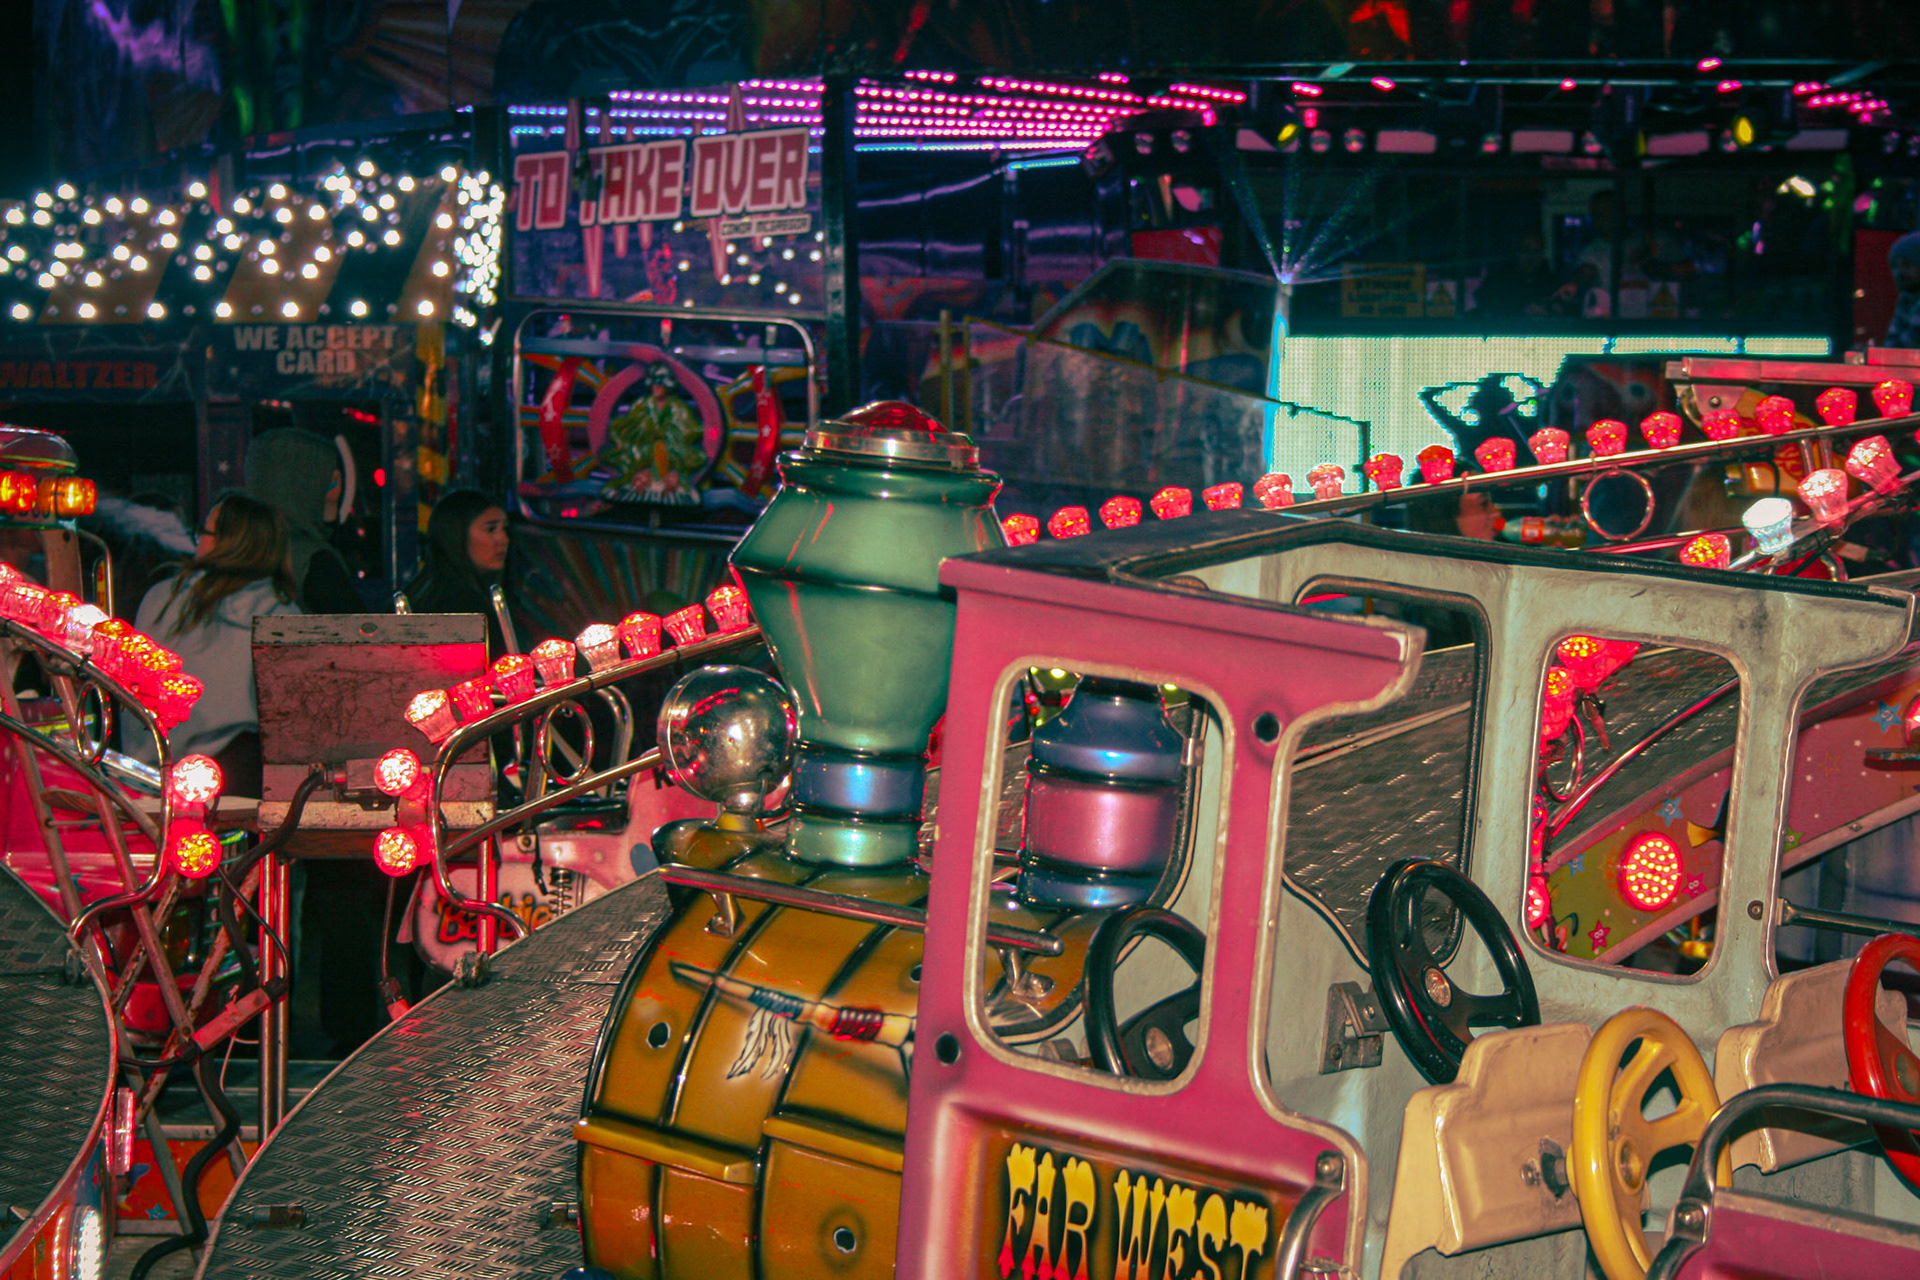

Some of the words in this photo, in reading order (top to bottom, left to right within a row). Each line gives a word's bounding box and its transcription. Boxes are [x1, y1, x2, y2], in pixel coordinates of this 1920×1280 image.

[515, 152, 569, 231] TO
[690, 127, 809, 217] OVER
[232, 325, 280, 351] WE
[285, 323, 399, 350] ACCEPT
[276, 349, 356, 375] CARD
[998, 1142, 1096, 1280] FAR
[1113, 1168, 1268, 1280] WEST
